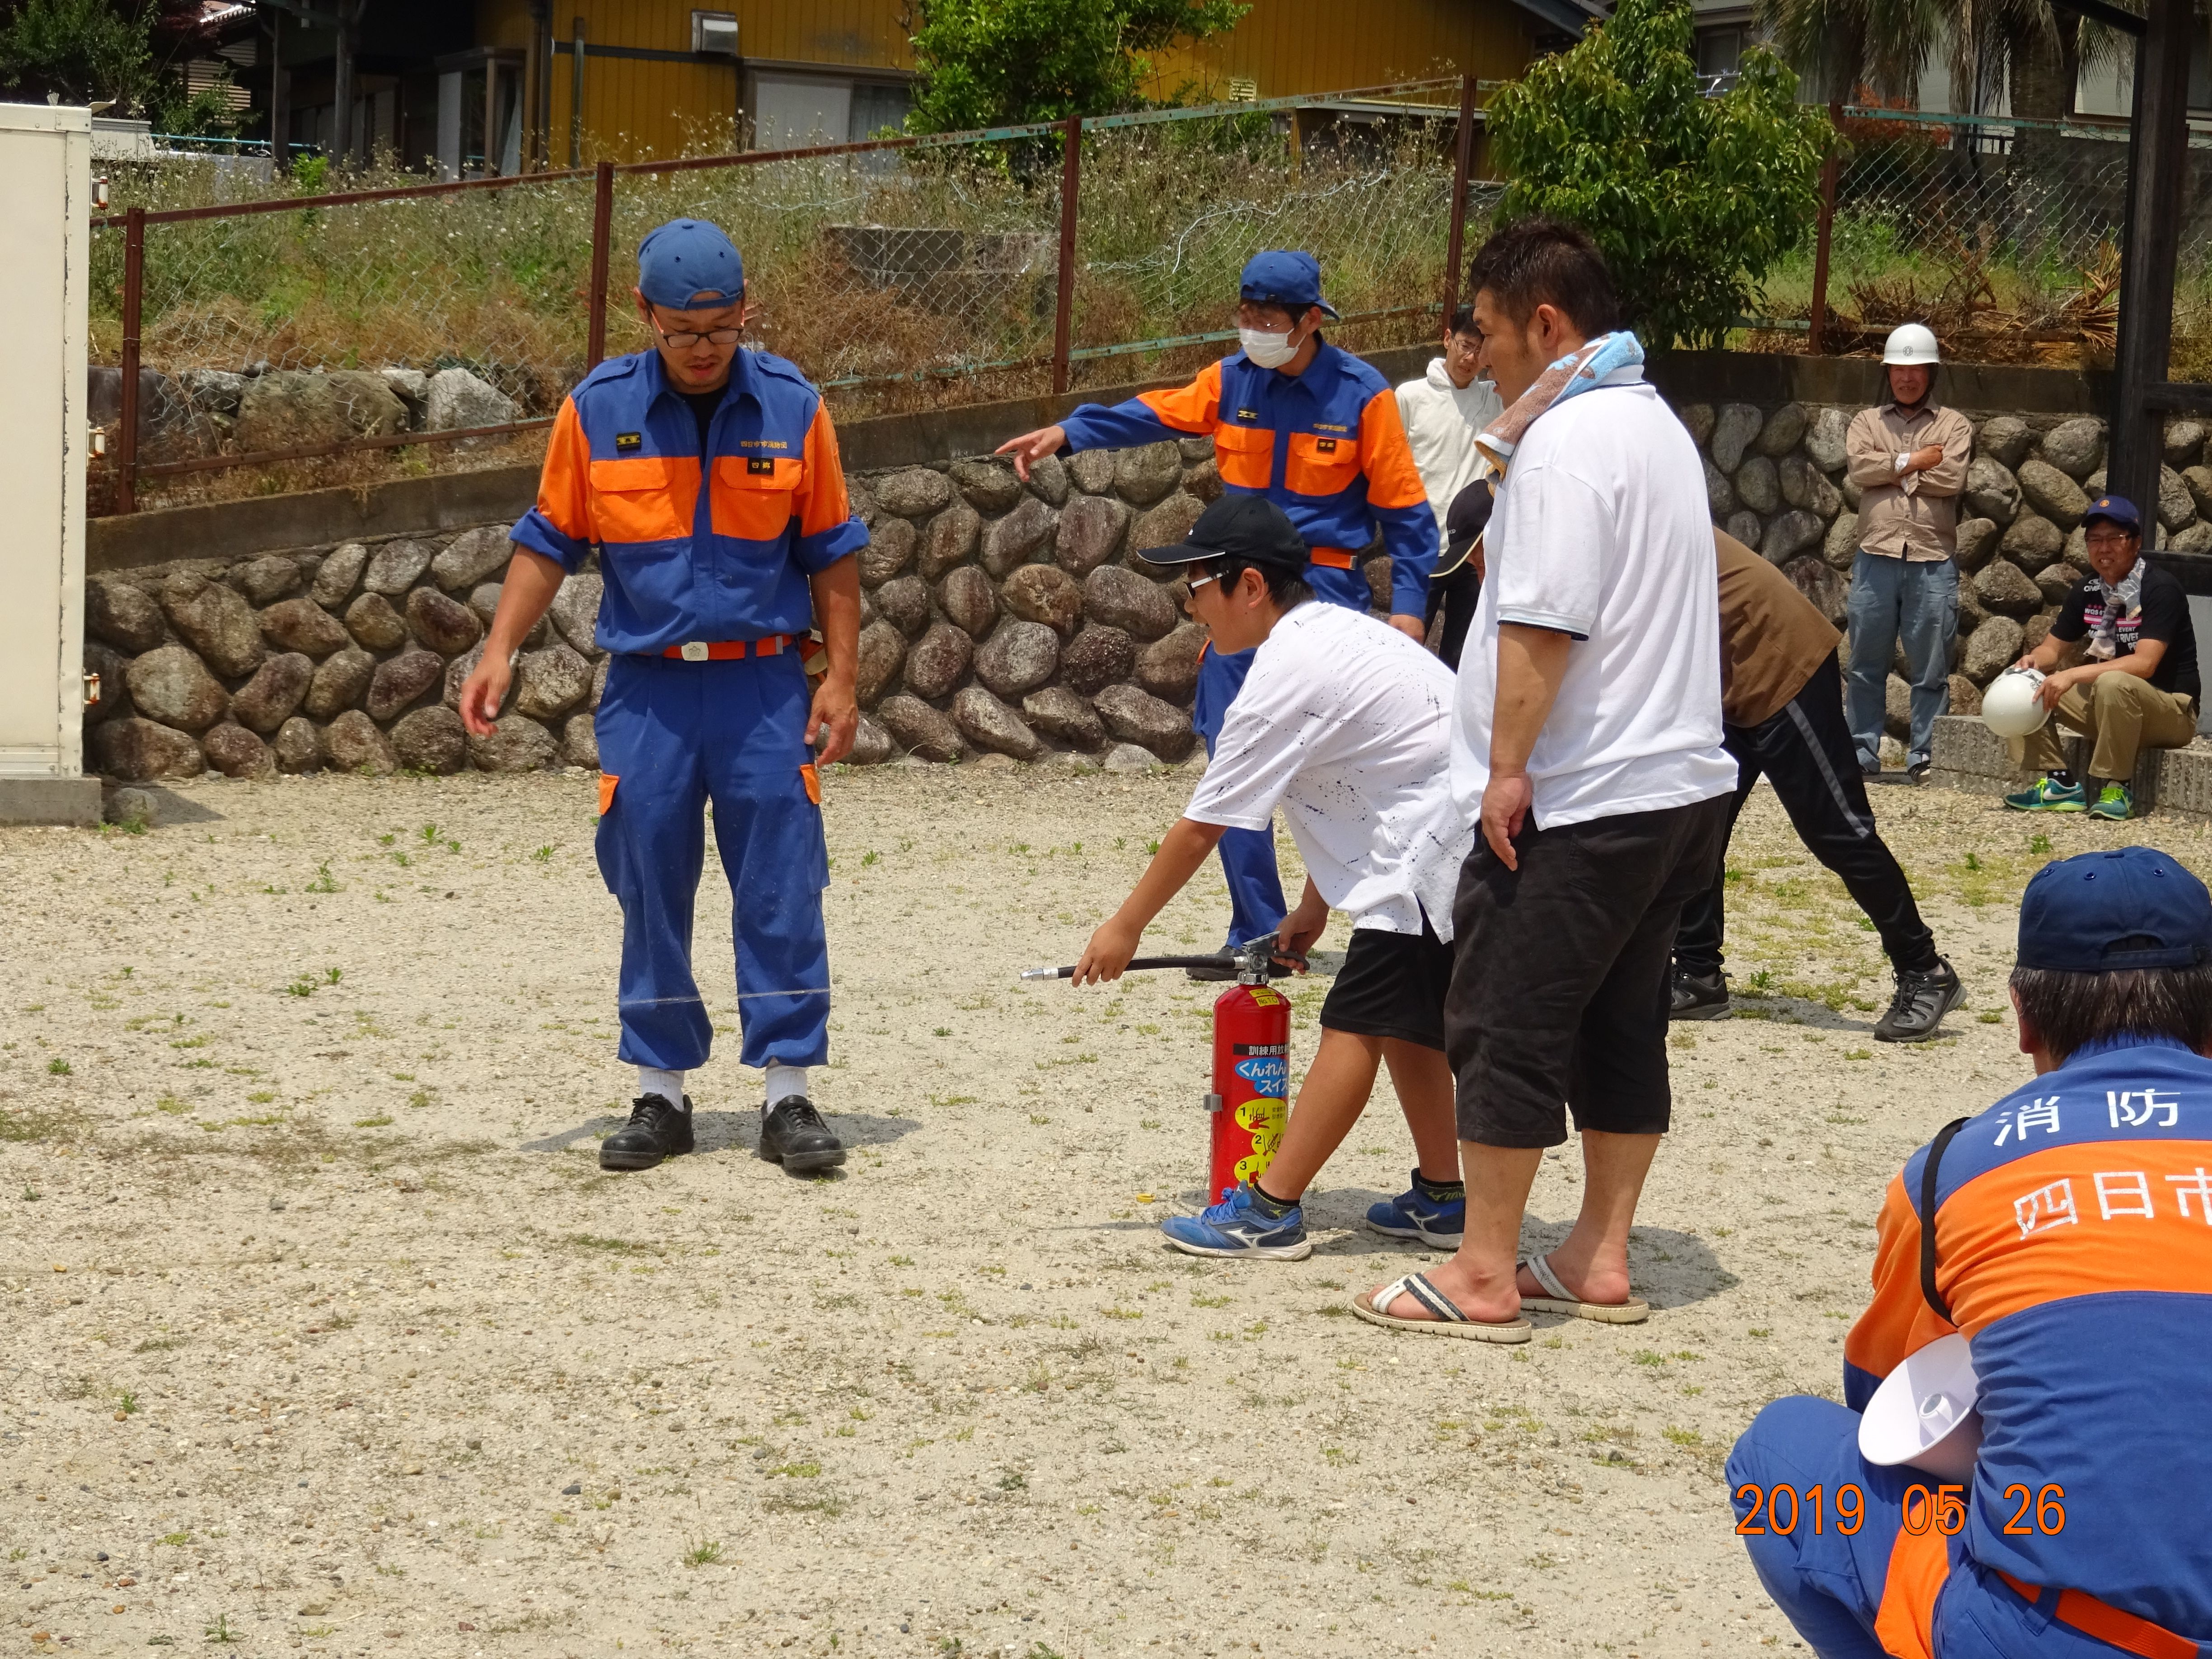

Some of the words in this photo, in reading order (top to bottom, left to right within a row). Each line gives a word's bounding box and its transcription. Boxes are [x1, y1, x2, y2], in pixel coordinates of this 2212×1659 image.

[1239, 1062, 1286, 1077] くんれん
[1240, 1107, 1246, 1116] 1
[1255, 1135, 1262, 1144] 2
[1240, 1161, 1247, 1170] 3
